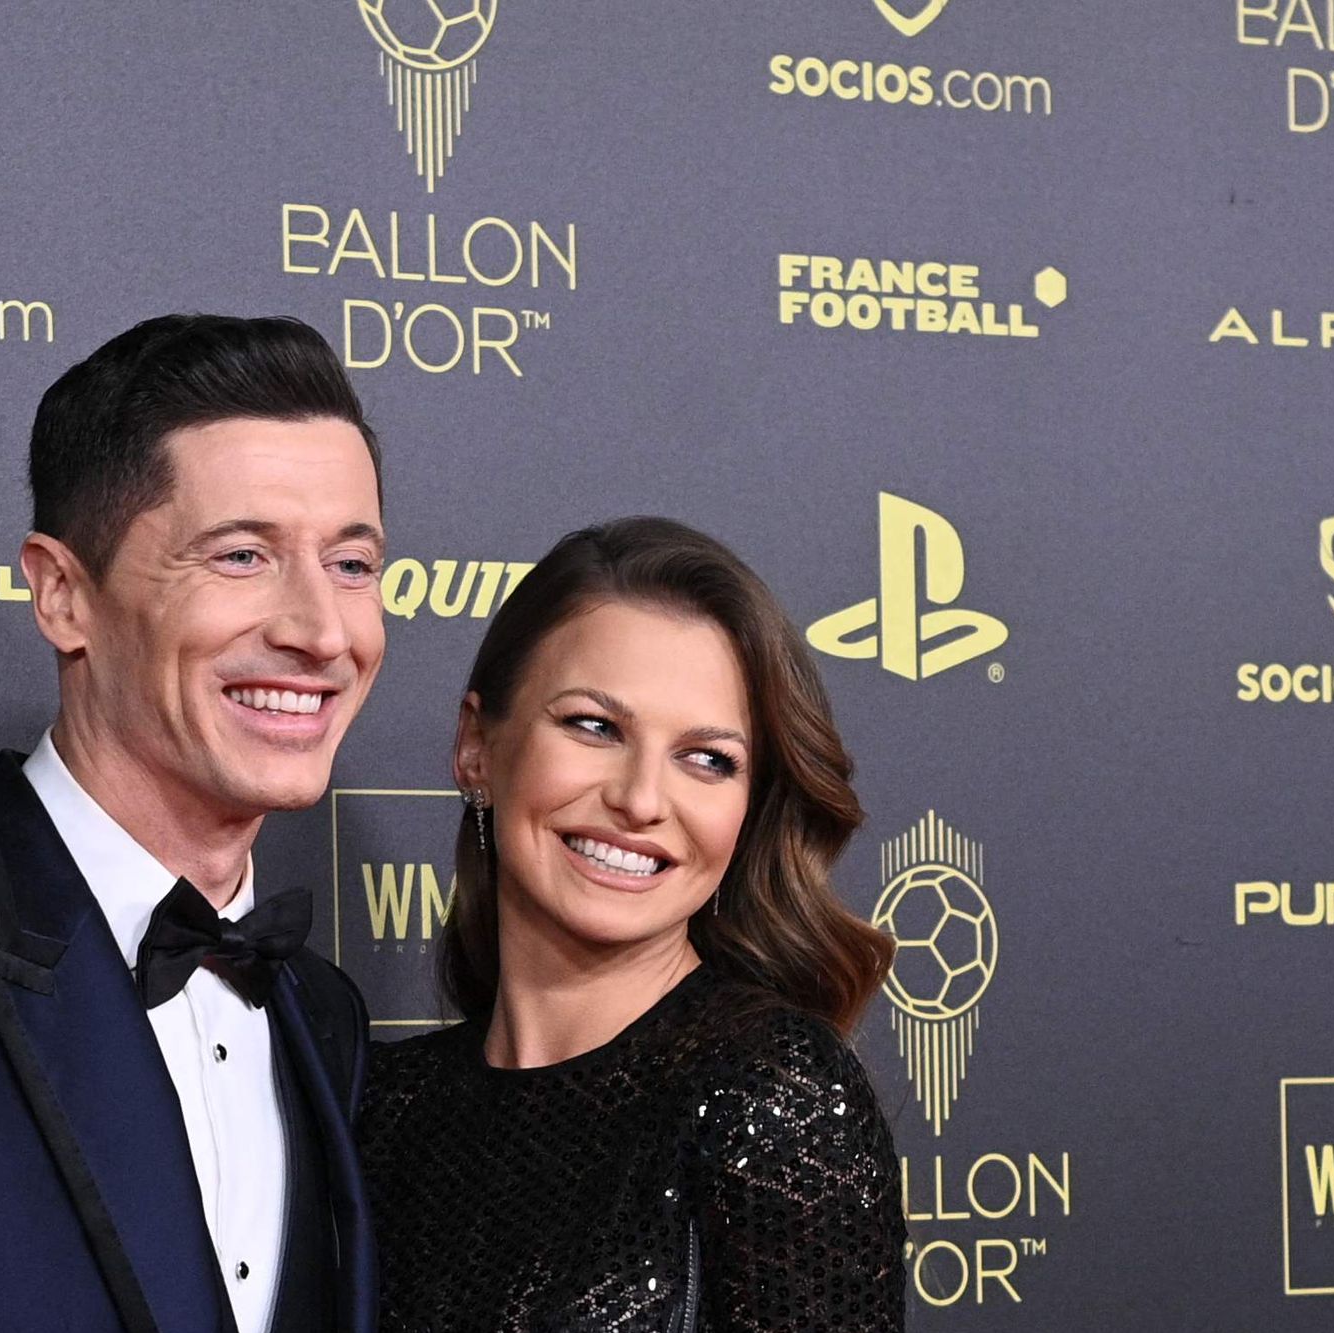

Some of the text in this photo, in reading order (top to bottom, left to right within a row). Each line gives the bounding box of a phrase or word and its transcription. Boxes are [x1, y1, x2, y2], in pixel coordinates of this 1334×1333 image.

[770, 55, 1051, 114] SOCIOS.com
[283, 204, 575, 290] BALLON
[779, 254, 979, 298] FRANCE
[780, 291, 1038, 337] FOOTBALL
